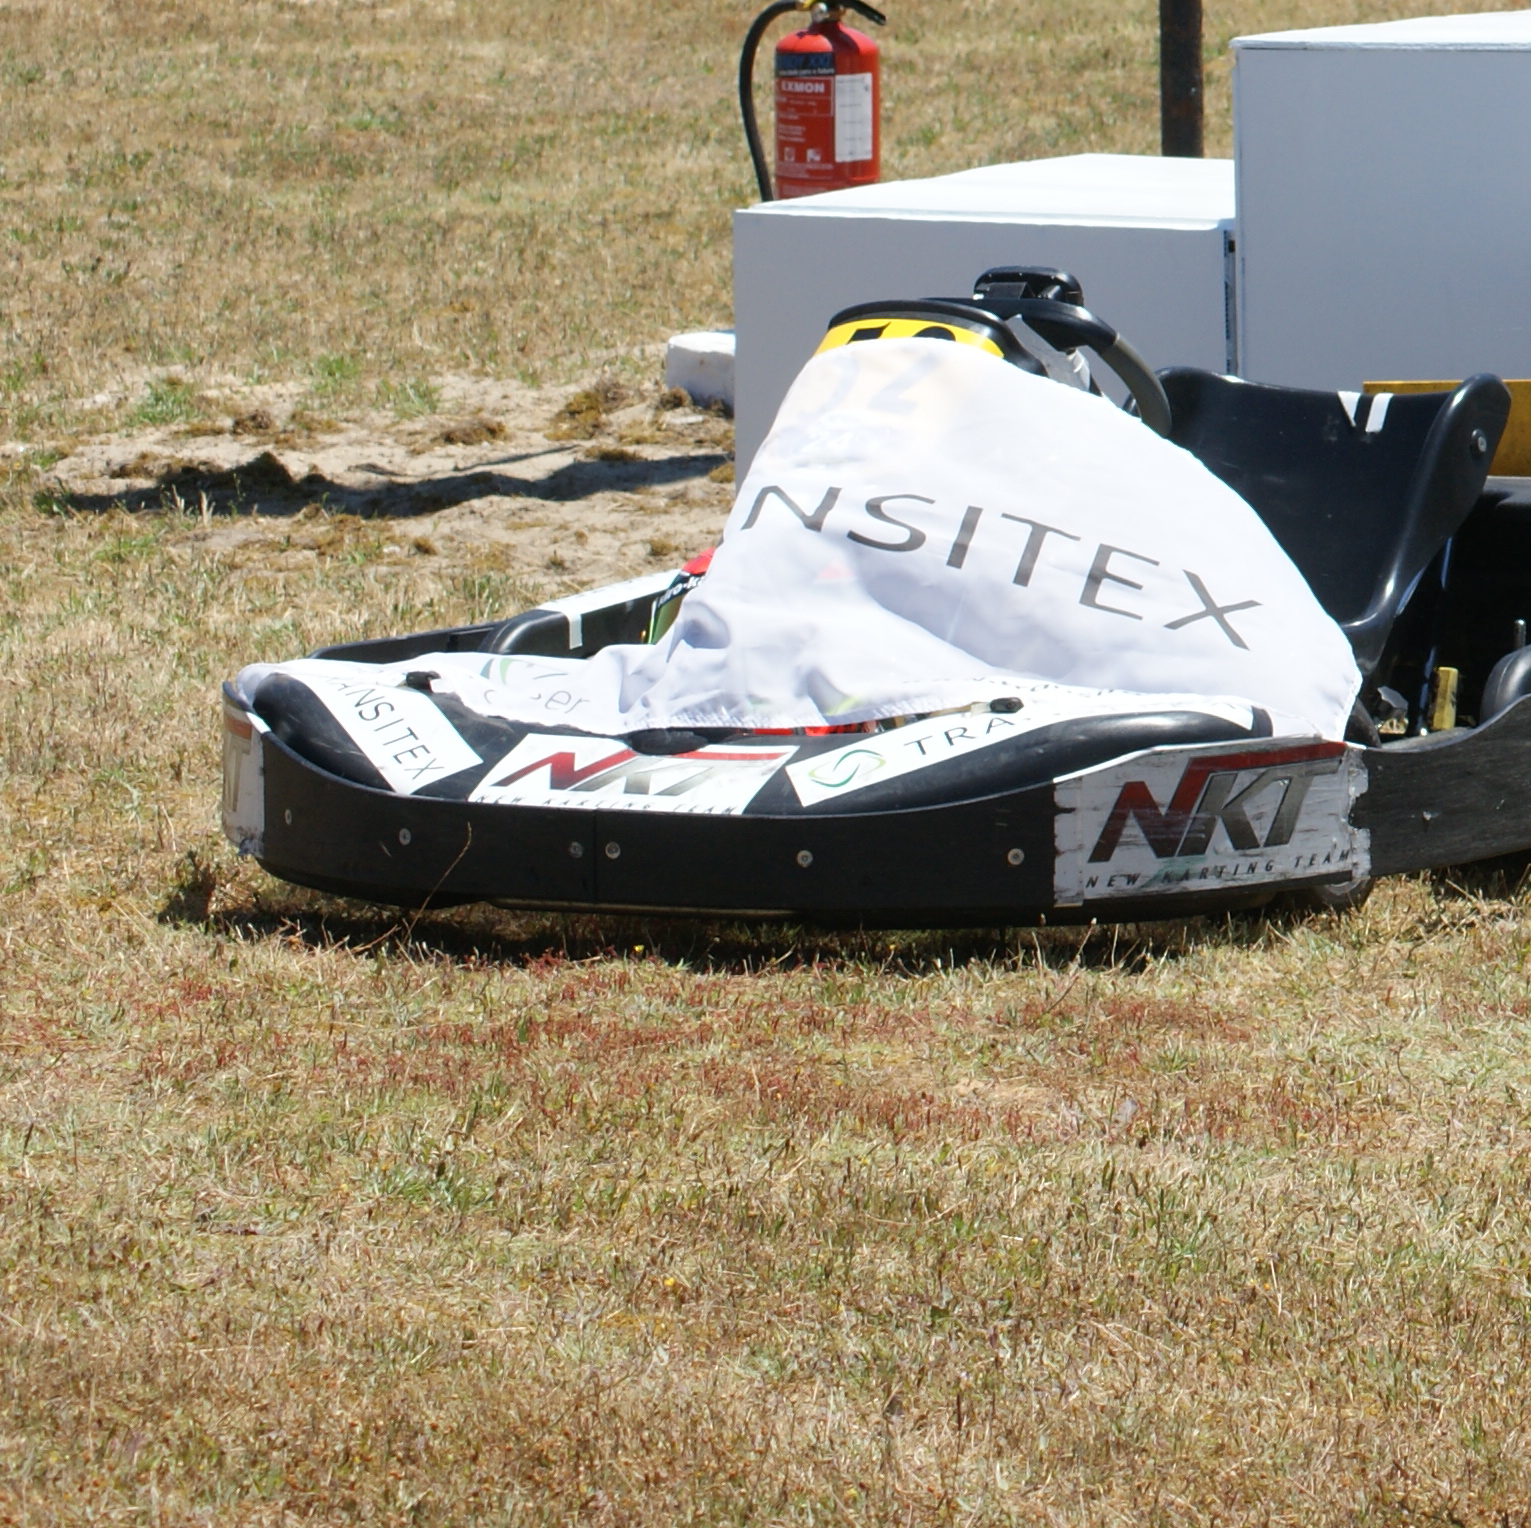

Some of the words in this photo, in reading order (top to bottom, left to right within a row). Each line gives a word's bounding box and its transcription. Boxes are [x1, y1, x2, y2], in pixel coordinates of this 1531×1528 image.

[1087, 741, 1347, 864] NKT
[1085, 873, 1141, 889] NEW
[1161, 859, 1275, 884] KARTING
[1293, 849, 1352, 869] TEAM
